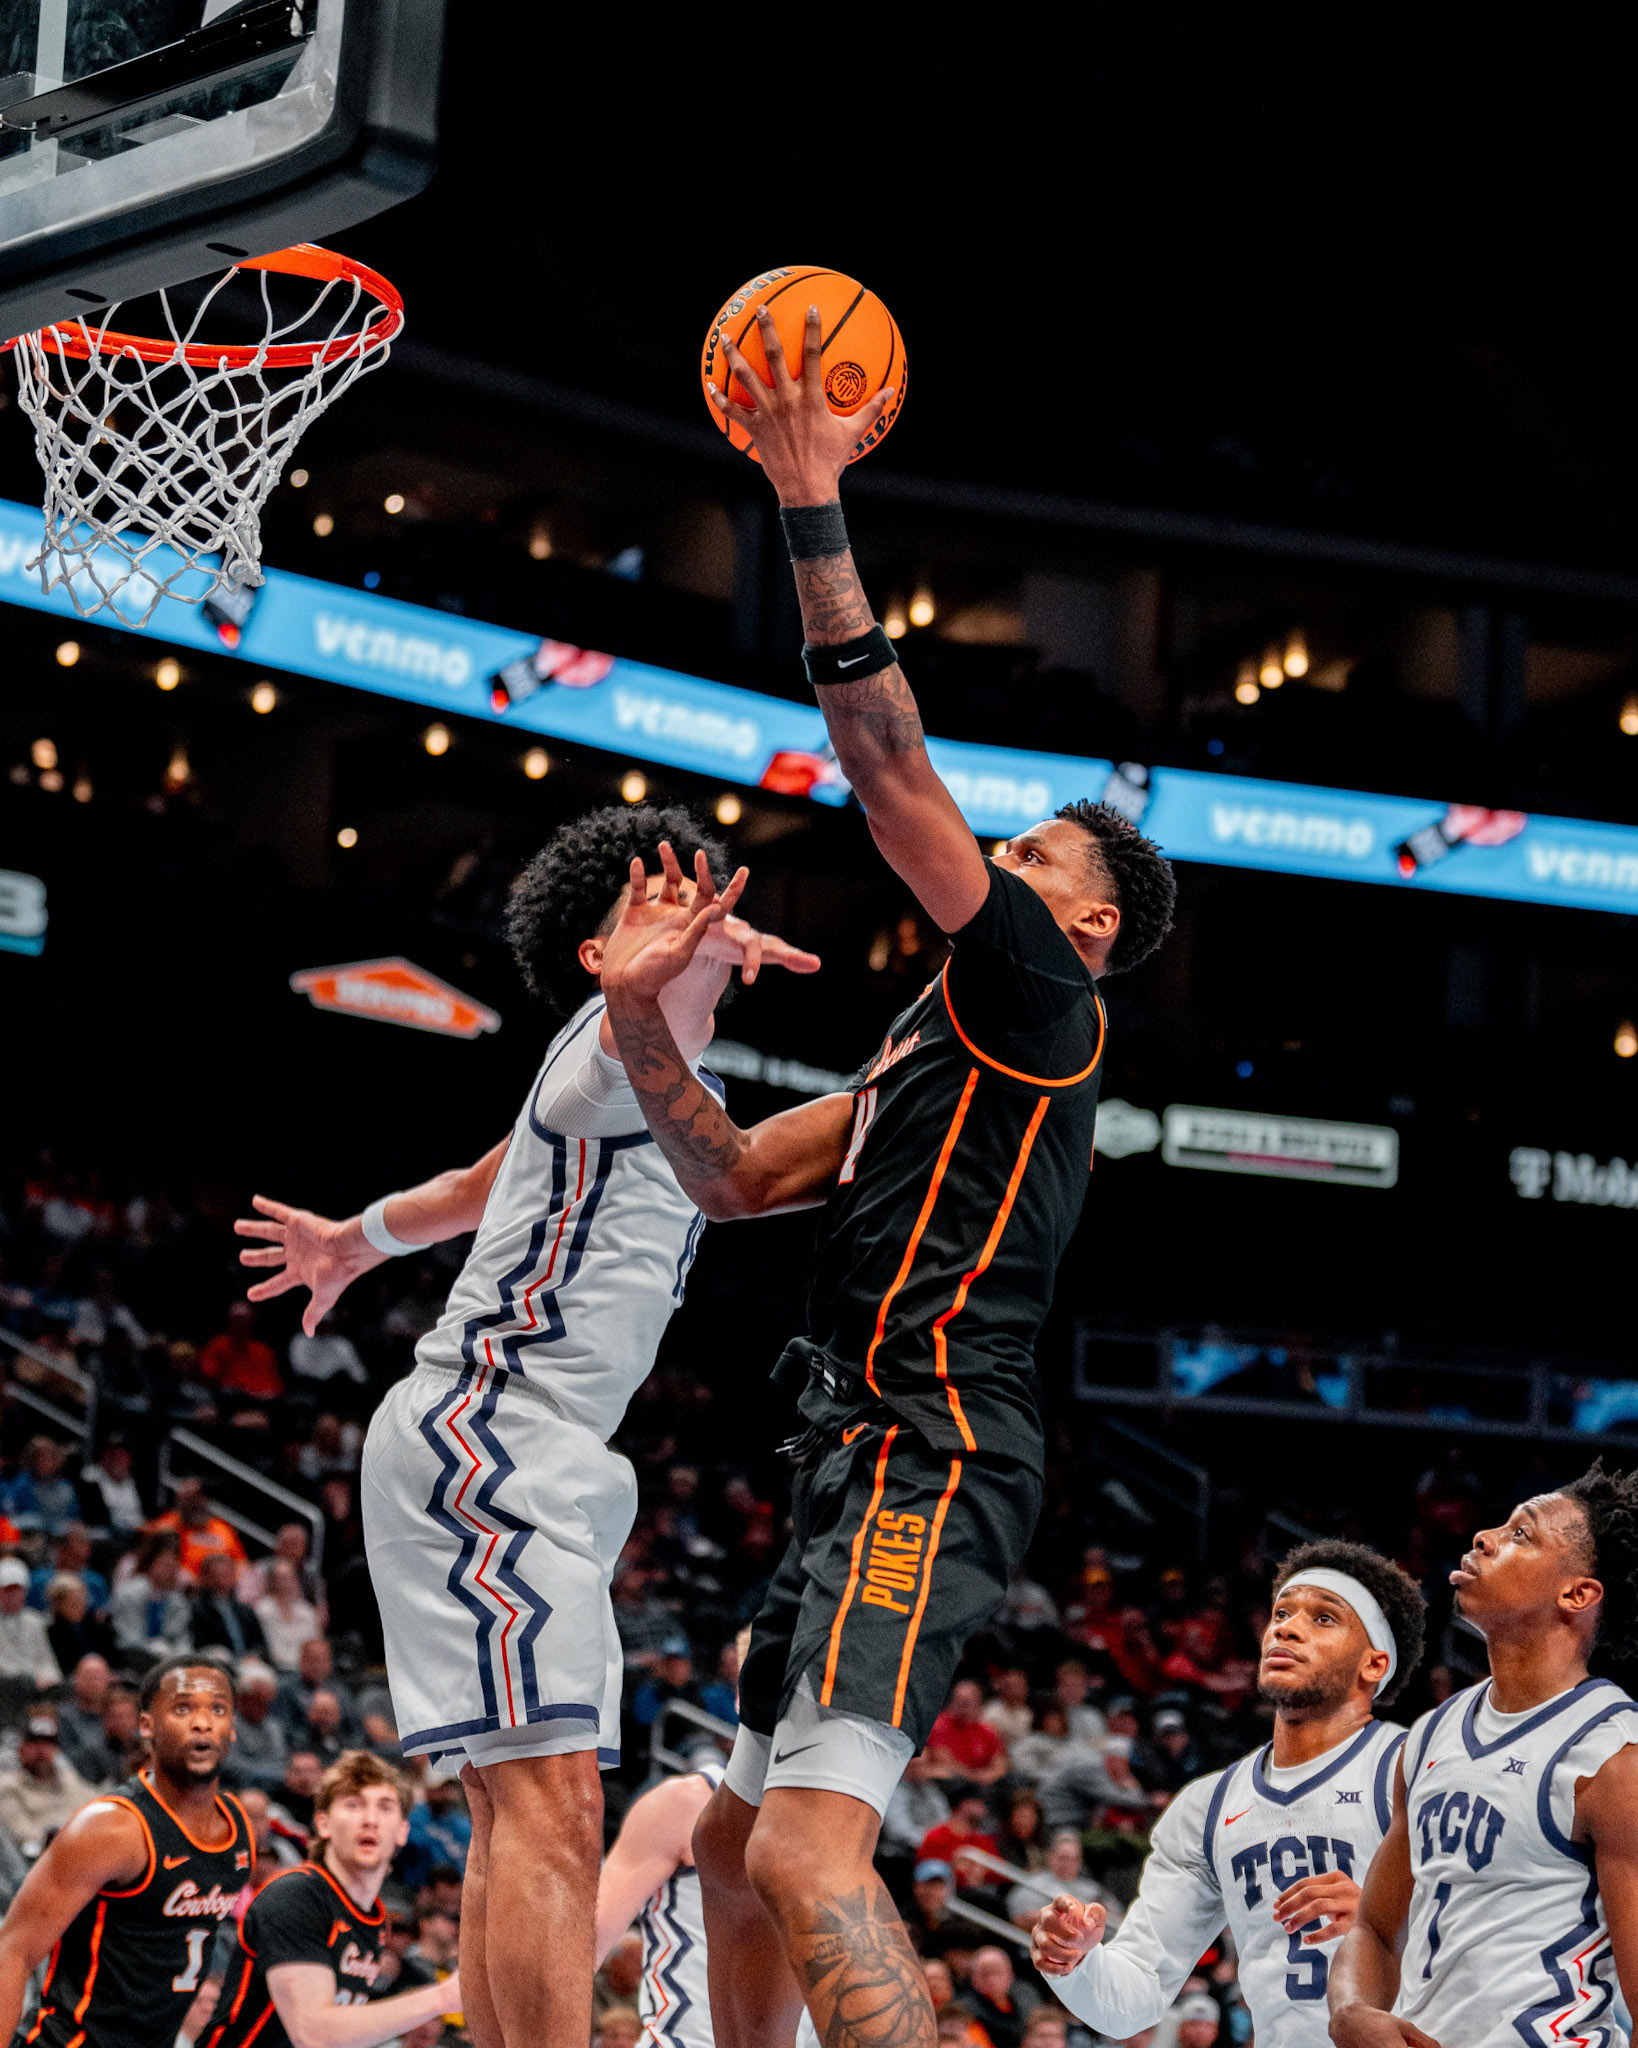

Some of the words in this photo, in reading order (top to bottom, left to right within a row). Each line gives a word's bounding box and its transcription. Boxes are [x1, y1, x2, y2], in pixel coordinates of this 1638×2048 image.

[861, 1509, 927, 1615] POKES
[1334, 1789, 1364, 1805] XII
[1416, 1791, 1506, 1874] TCU
[1231, 1835, 1356, 1912] TCU
[172, 1928, 210, 1992] 1
[1282, 1915, 1329, 2000] 5
[1422, 1882, 1453, 1979] 1
